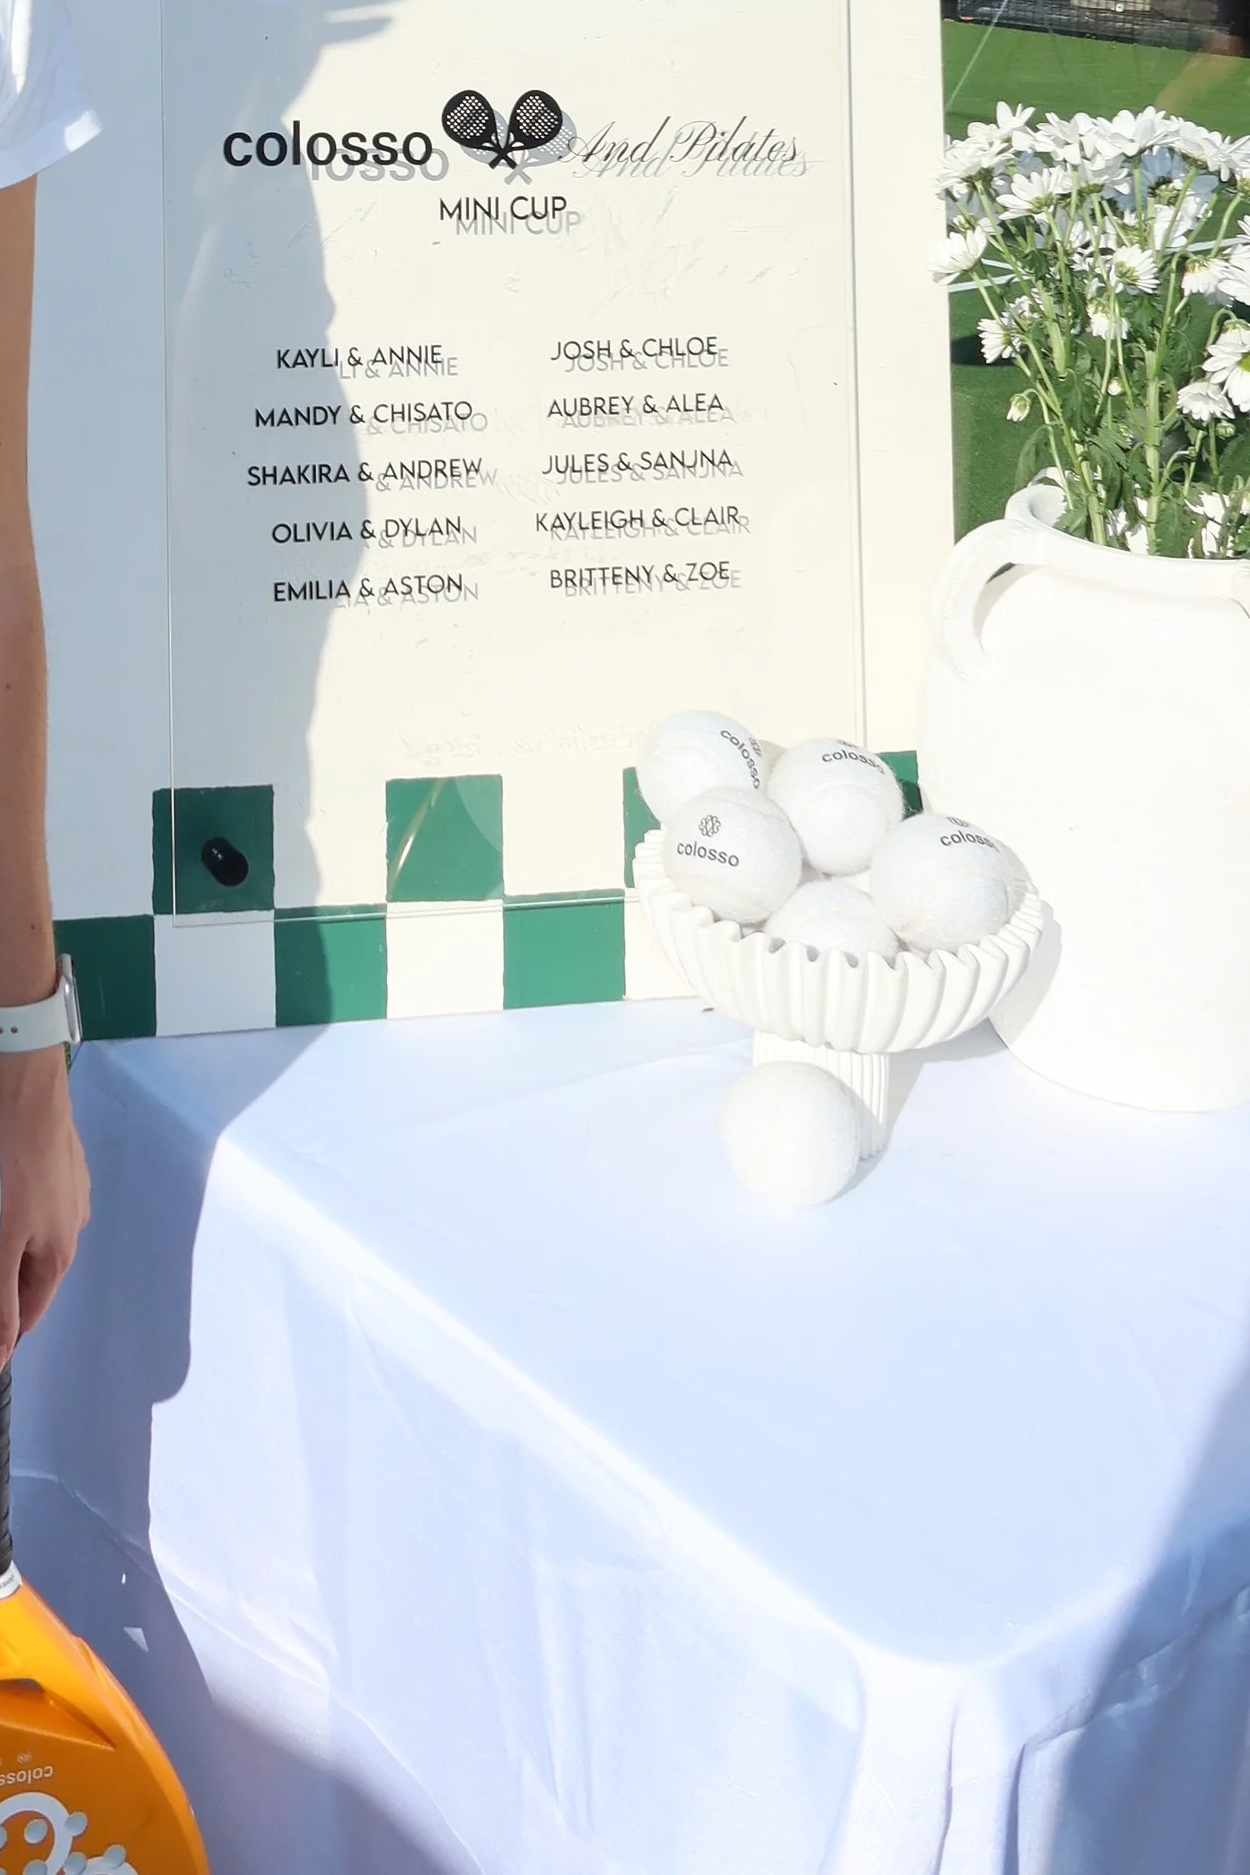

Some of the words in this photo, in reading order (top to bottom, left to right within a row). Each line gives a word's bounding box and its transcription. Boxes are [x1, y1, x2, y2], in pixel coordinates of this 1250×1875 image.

[222, 120, 433, 167] colosso
[557, 116, 671, 163] And
[669, 116, 798, 163] Pilates
[439, 196, 500, 222] MINI
[510, 195, 567, 220] CUP
[277, 347, 339, 369] KAYLI
[347, 347, 363, 367] &
[372, 344, 442, 366] ANNIE
[551, 339, 611, 360] JOSH
[619, 339, 635, 358] &
[642, 336, 718, 357] CHLOE
[255, 405, 341, 427] MANDY
[349, 404, 366, 424] &
[373, 401, 472, 423] CHISATO
[547, 396, 634, 417] AUBREY
[643, 394, 658, 413] &
[666, 393, 724, 413] ALEA
[247, 463, 350, 487] SHAKIRA
[358, 462, 374, 482] &
[383, 457, 483, 480] ANDREW
[542, 453, 609, 475] JULES
[617, 452, 633, 471] &
[640, 449, 733, 470] SANJNA
[272, 521, 352, 543] OLIVIA
[360, 519, 376, 539] &
[385, 516, 461, 537] DYLAN
[536, 509, 643, 532] KAYLEIGH
[652, 508, 667, 527] &
[675, 506, 740, 526] CLAIR
[273, 580, 351, 602] EMILIA
[359, 577, 375, 597] &
[384, 574, 462, 595] ASTON
[550, 565, 654, 589] BRITTENY
[663, 563, 679, 583] &
[686, 561, 730, 581] ZOE
[720, 730, 761, 790] colosso
[822, 749, 885, 775] colosso
[676, 840, 740, 868] colosso
